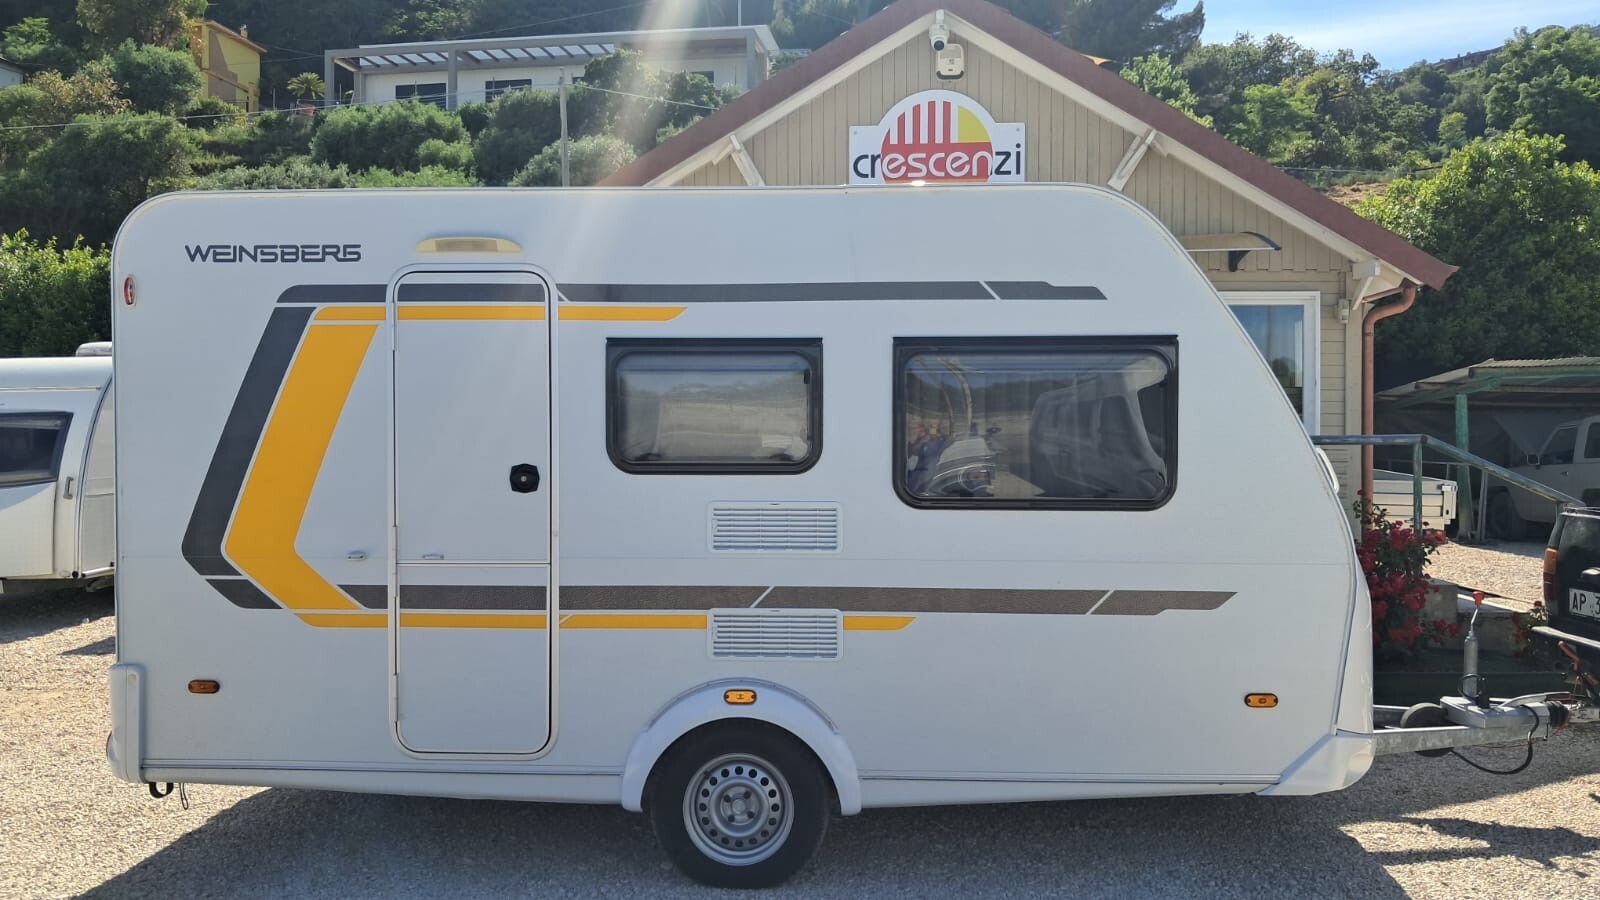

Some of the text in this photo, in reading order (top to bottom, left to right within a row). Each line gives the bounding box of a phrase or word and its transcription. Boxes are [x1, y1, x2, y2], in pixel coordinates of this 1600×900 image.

[852, 142, 1021, 179] crescenzi
[184, 244, 361, 263] WEINSBERG
[1572, 591, 1587, 612] AP
